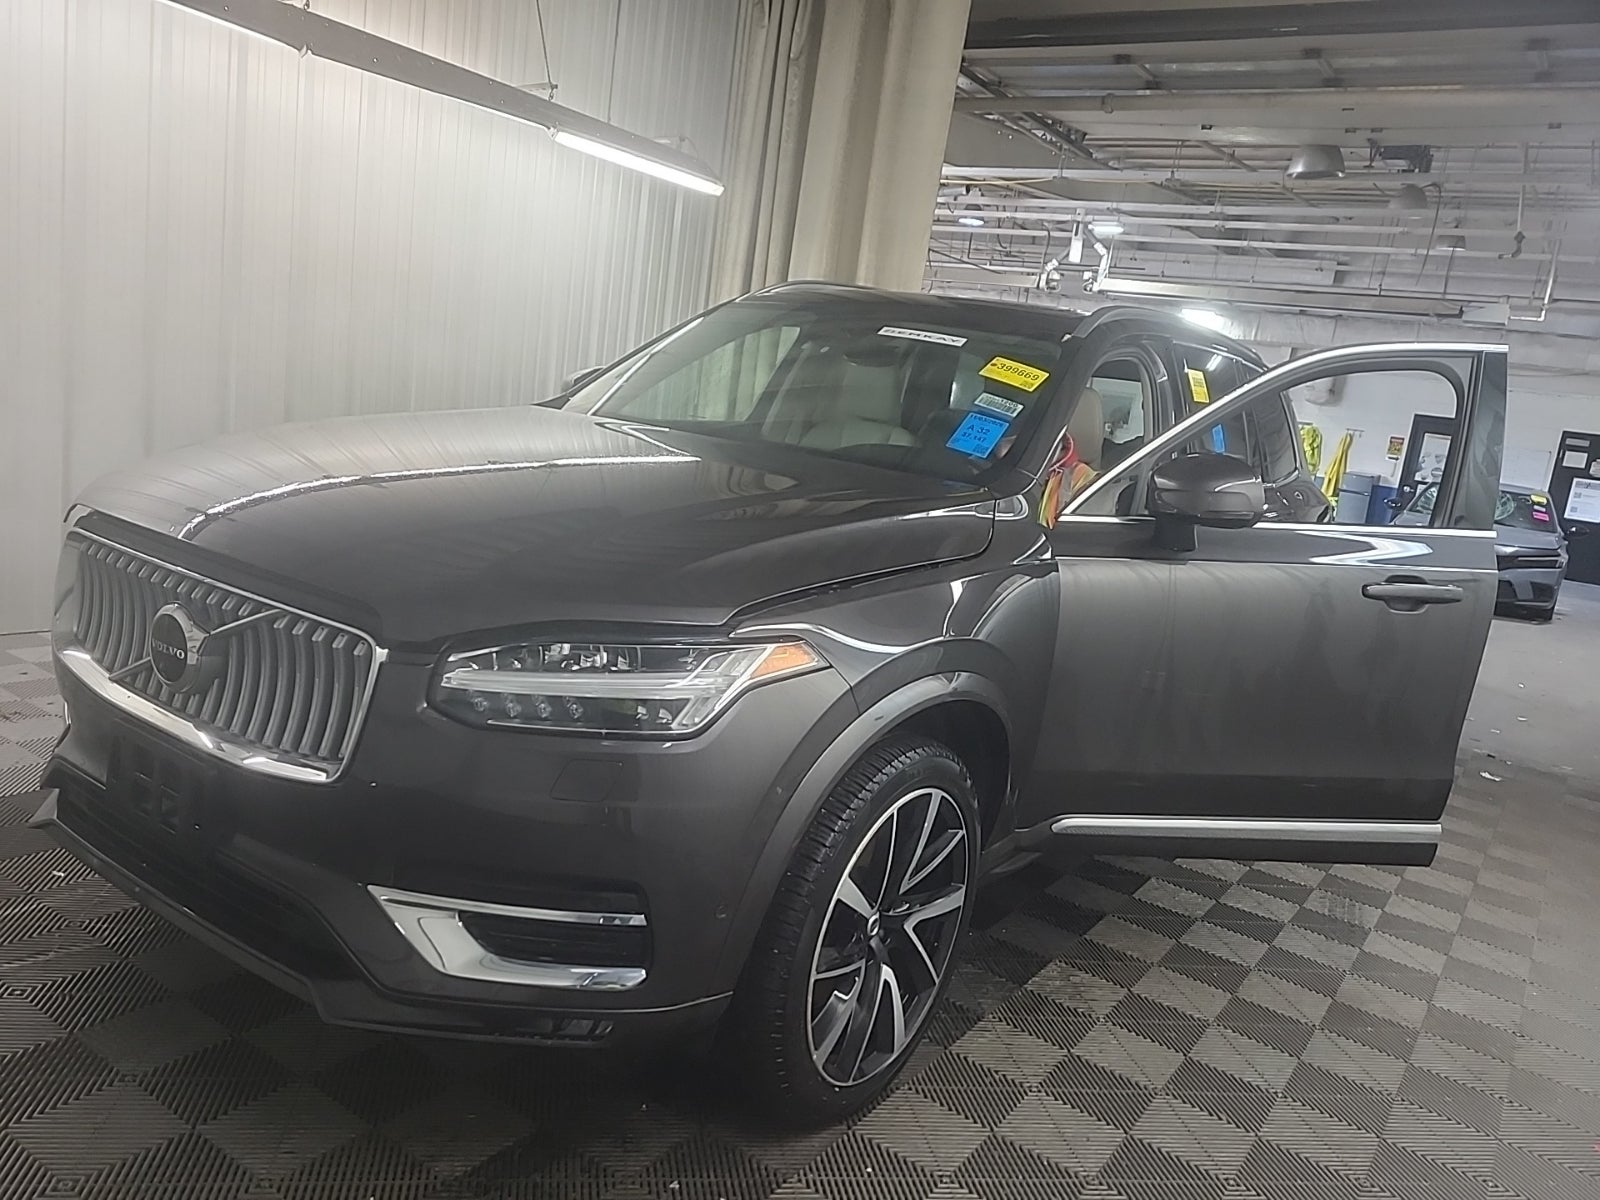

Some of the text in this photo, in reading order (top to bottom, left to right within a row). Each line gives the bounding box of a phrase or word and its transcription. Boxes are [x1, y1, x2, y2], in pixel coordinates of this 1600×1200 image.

[997, 362, 1040, 381] 399669
[967, 424, 991, 436] A 32
[151, 637, 185, 660] VOLVO
